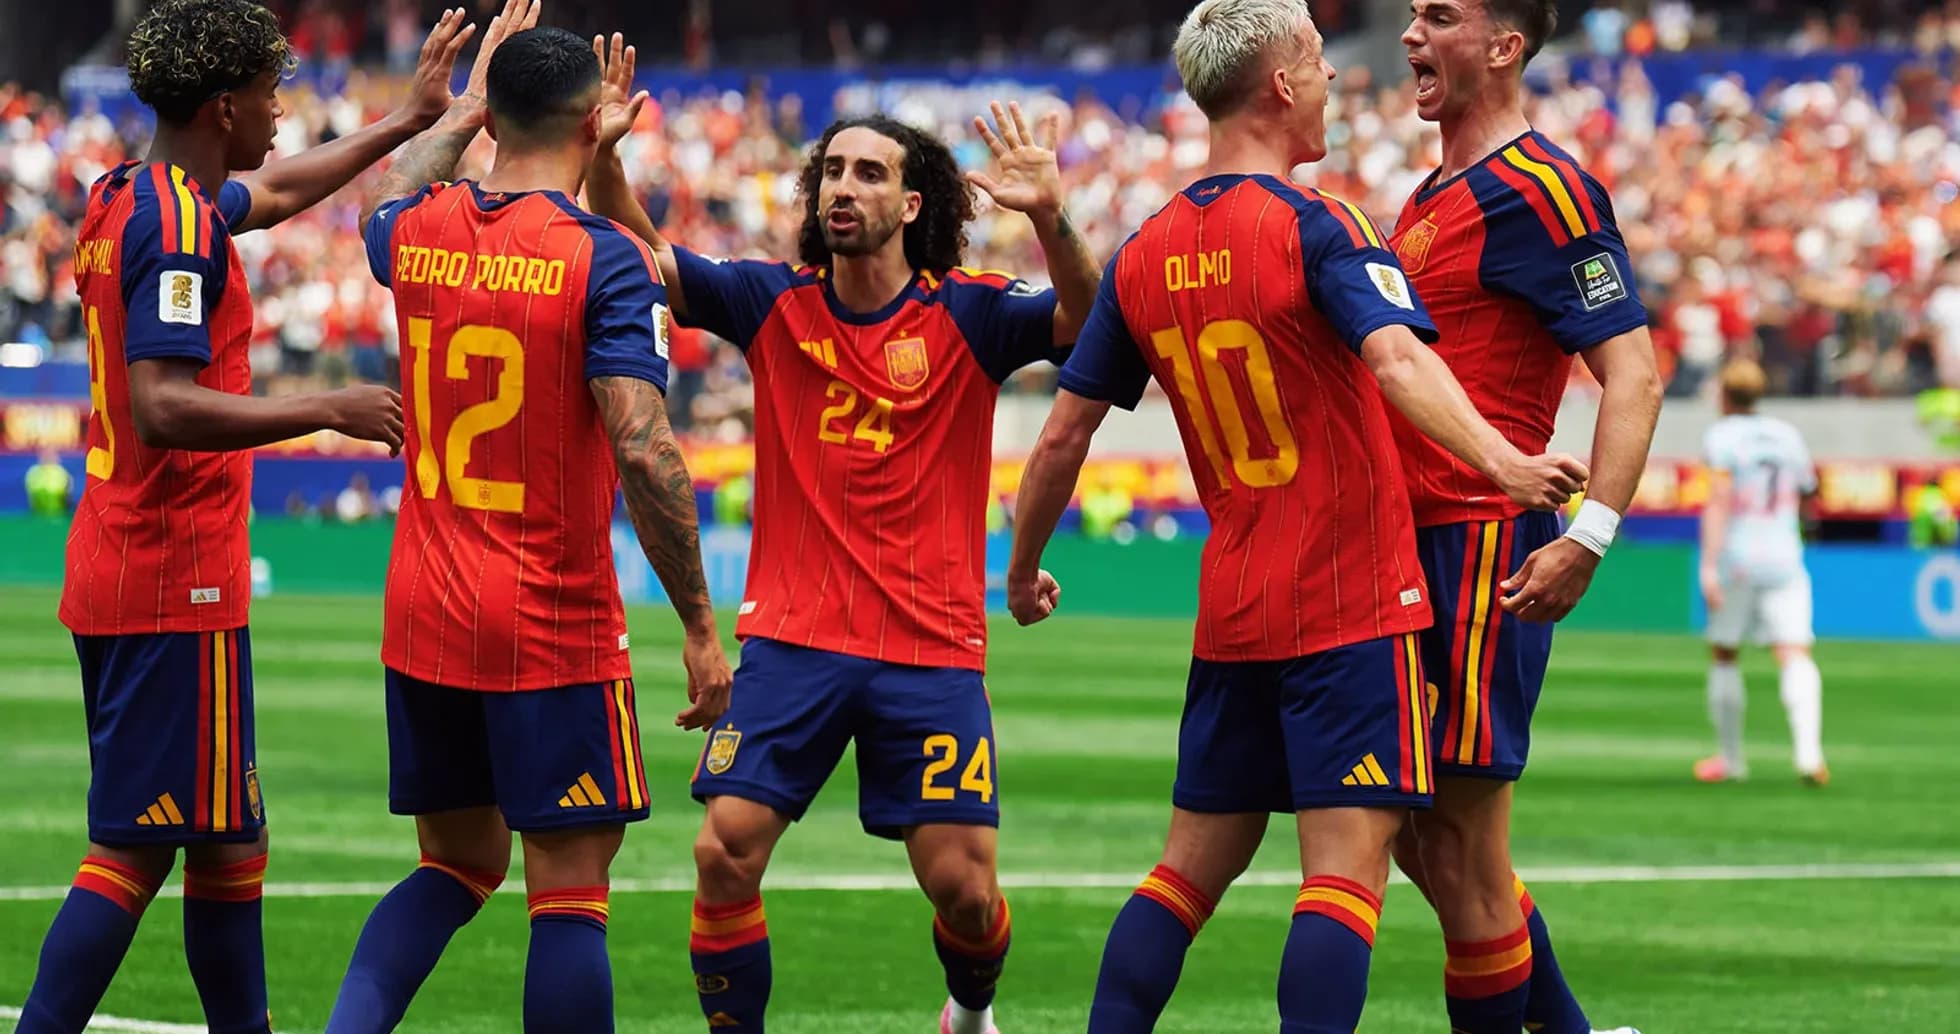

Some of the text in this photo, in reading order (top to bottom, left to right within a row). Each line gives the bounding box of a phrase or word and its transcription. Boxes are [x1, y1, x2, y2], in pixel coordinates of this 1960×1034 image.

[396, 244, 566, 296] PEDRO PORRO
[1165, 248, 1231, 292] OLMO
[1587, 281, 1619, 300] EDUCATION
[407, 315, 526, 514] 12
[818, 380, 894, 453] 24
[1151, 319, 1299, 488] 10
[921, 734, 994, 804] 24
